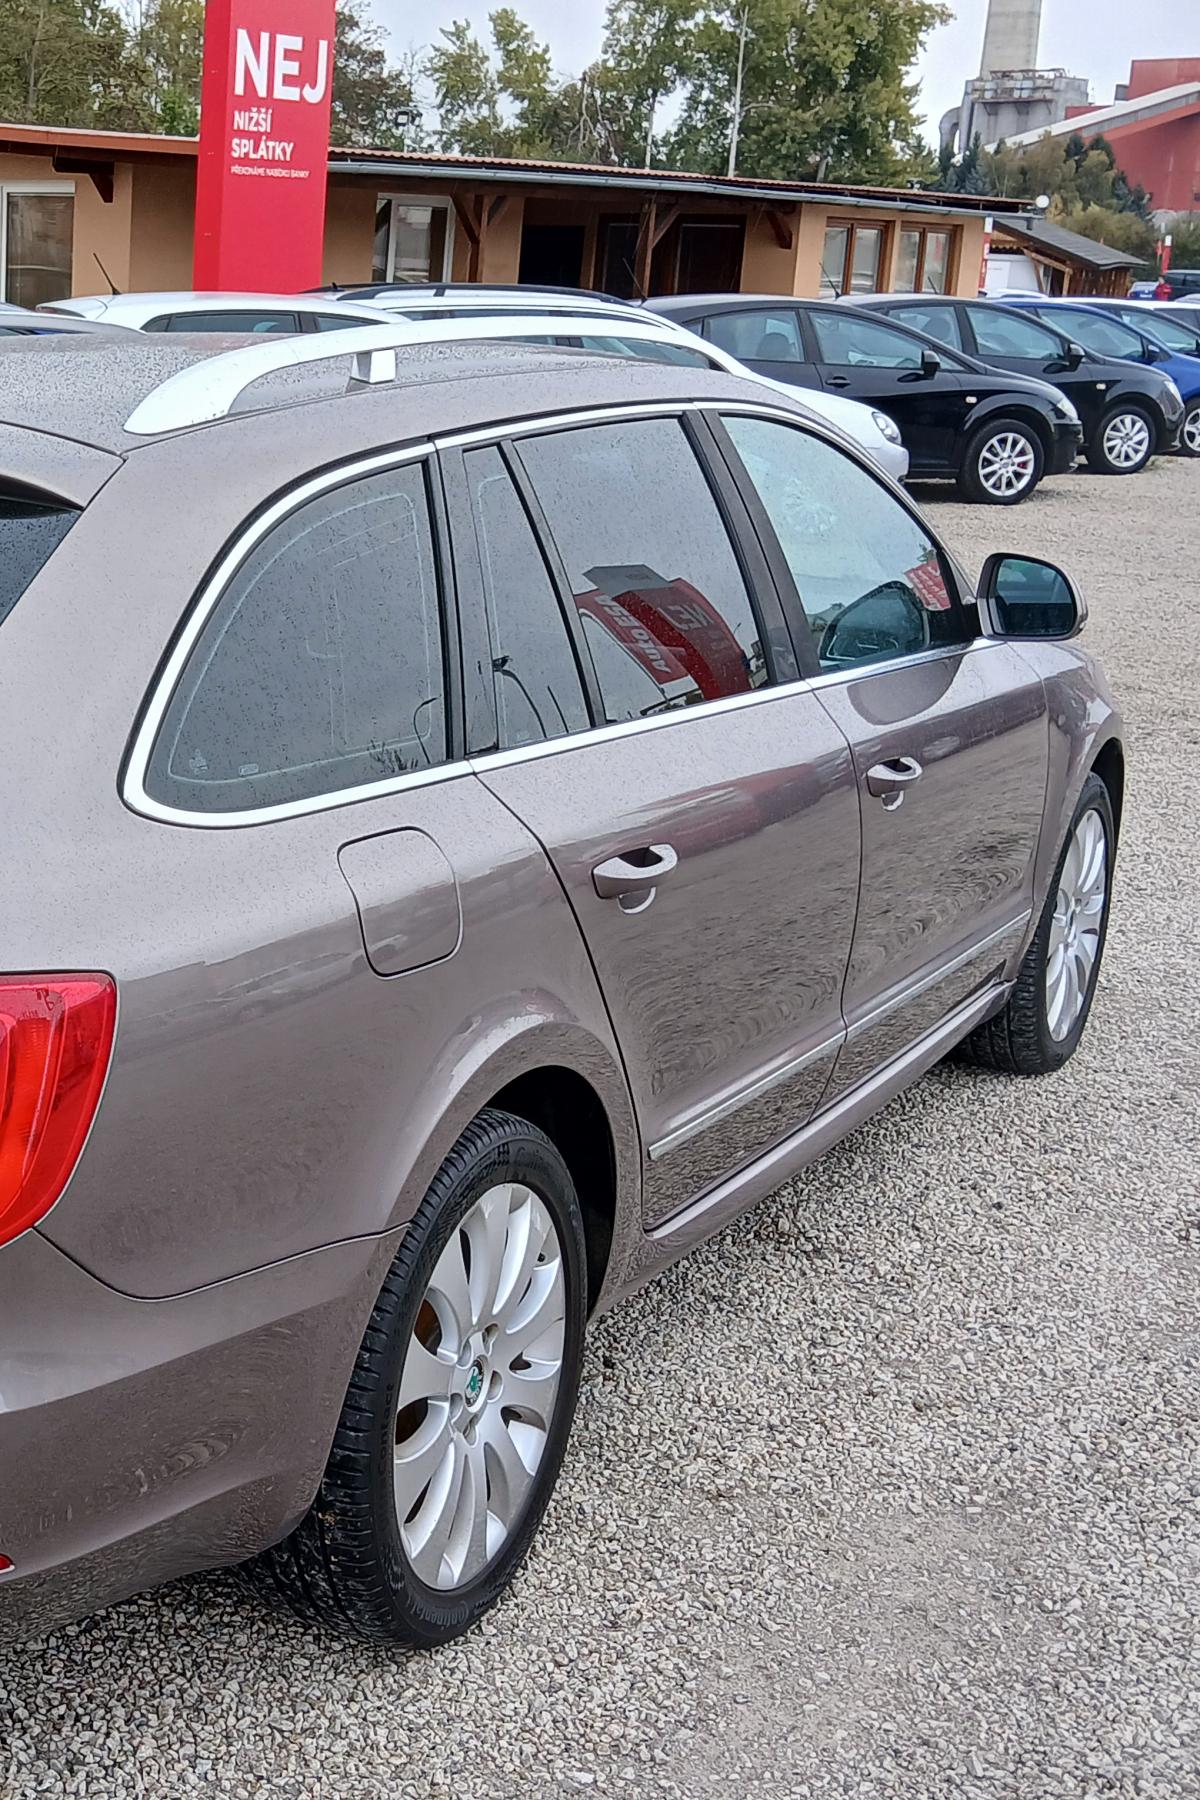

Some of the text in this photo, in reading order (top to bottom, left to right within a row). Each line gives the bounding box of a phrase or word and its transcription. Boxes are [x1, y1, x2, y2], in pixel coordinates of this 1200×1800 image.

[234, 28, 328, 104] NEJ
[233, 106, 273, 133] NIŽŠÍ
[231, 134, 295, 161] SPLÁTKY
